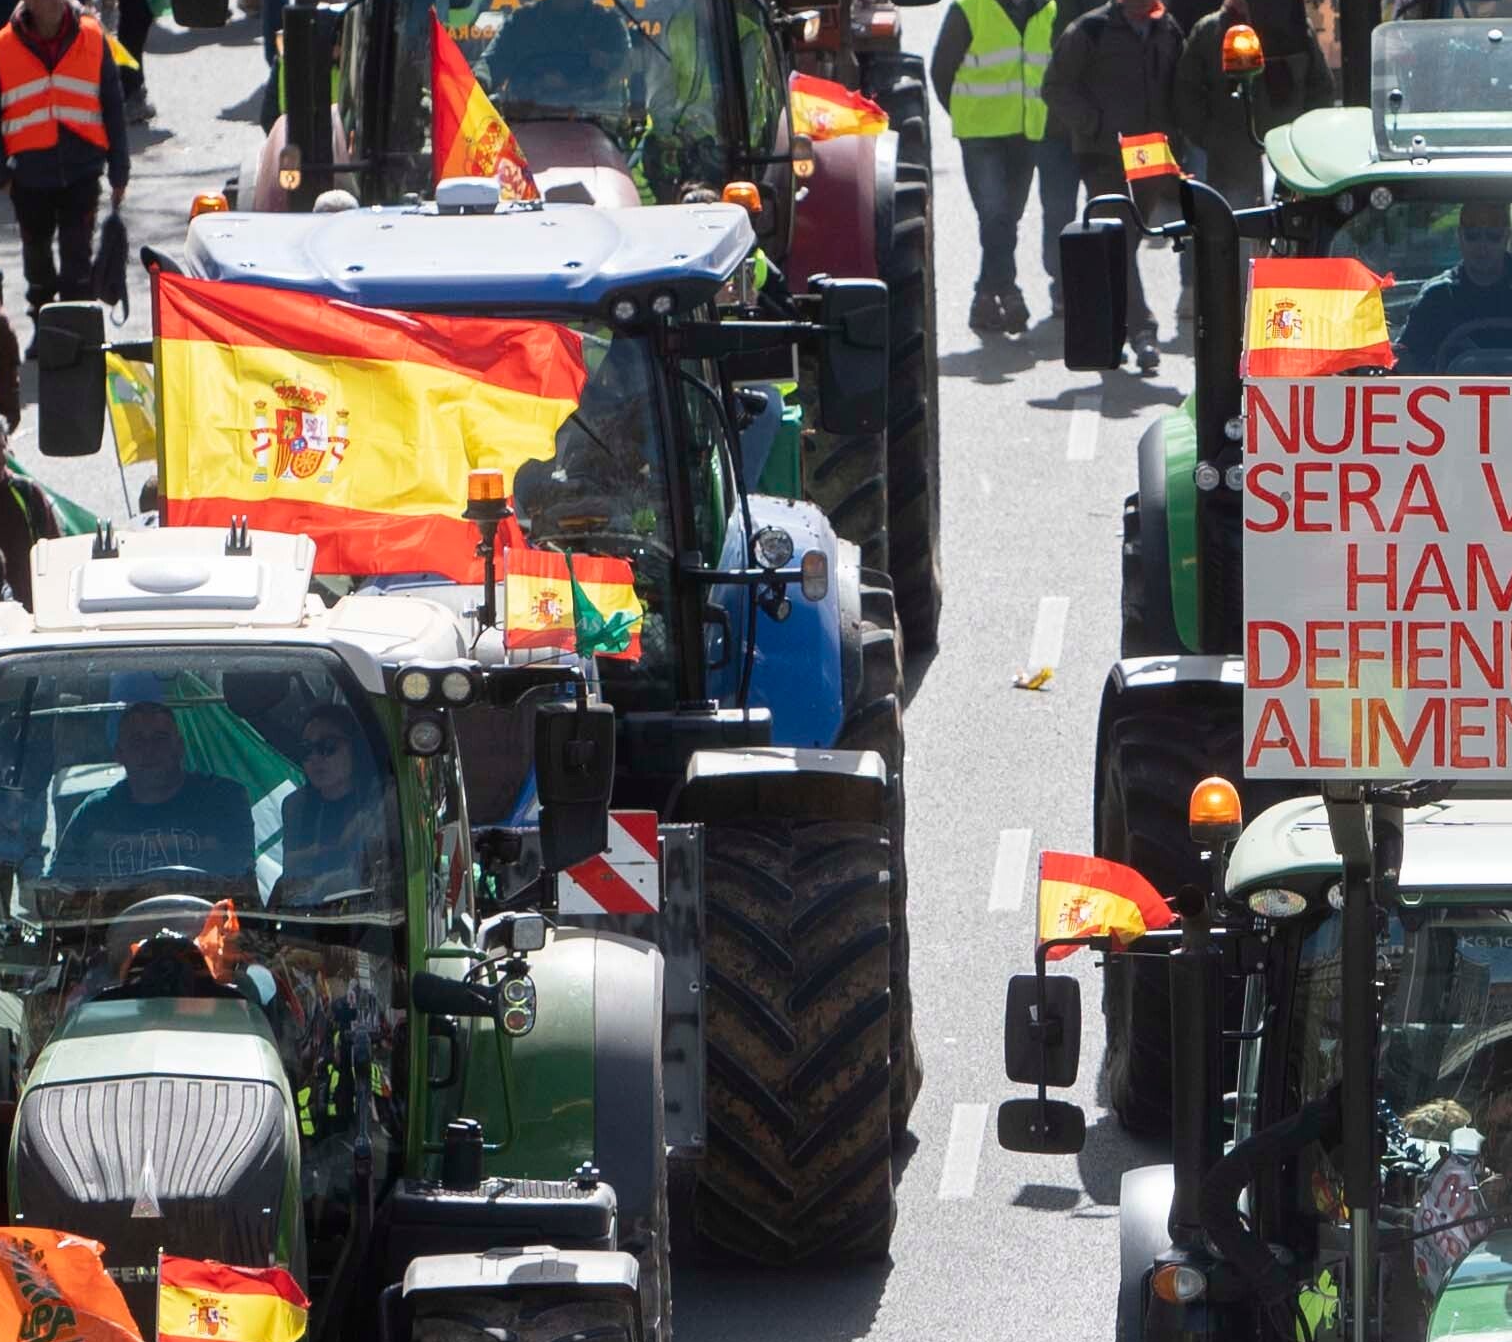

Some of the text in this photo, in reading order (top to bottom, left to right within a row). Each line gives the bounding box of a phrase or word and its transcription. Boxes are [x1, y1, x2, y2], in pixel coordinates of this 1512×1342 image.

[1244, 461, 1446, 534] SERA
[109, 1267, 161, 1283] FEN
[17, 1305, 77, 1342] UPA
